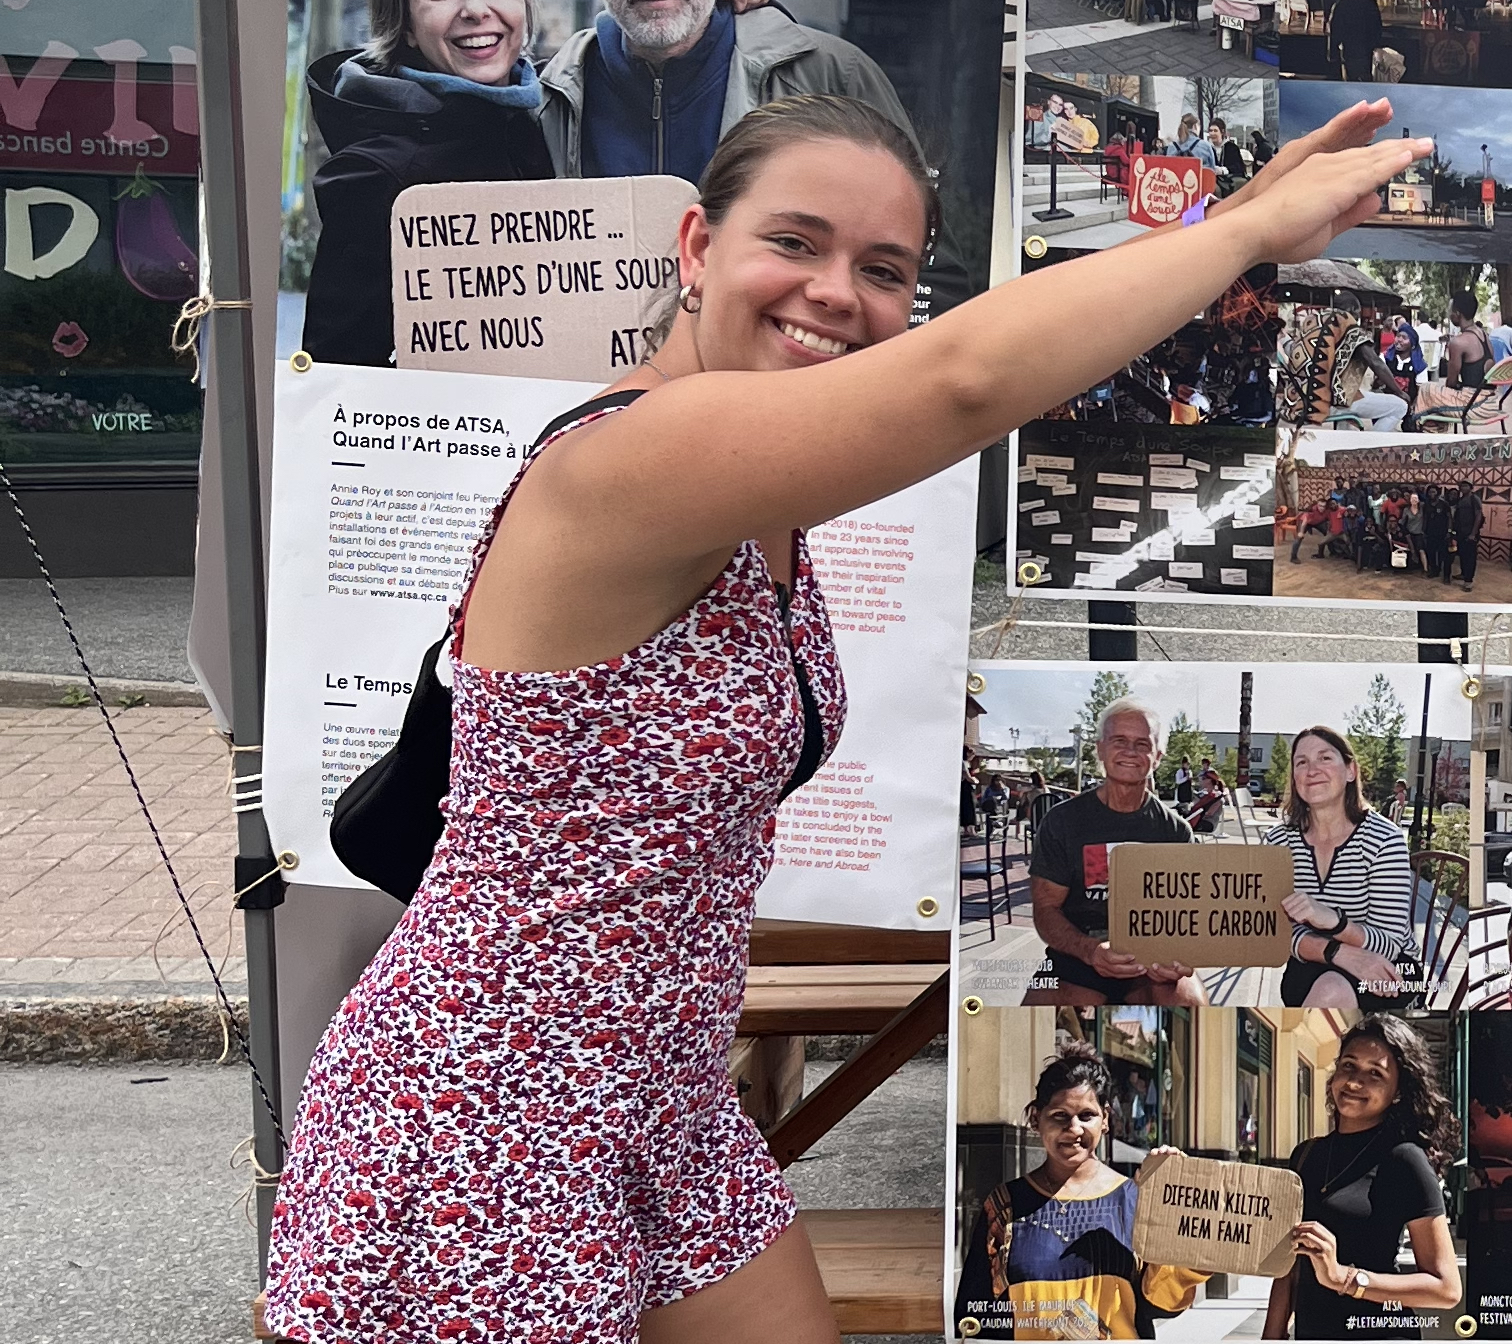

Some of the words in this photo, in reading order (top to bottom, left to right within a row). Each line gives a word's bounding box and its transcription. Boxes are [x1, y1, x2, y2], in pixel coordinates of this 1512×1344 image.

[1221, 16, 1242, 28] ATSA
[399, 213, 479, 248] VENEZ
[491, 208, 596, 244] PRENDRE
[404, 269, 433, 301] LE
[443, 265, 527, 299] TEMPS
[538, 260, 602, 294] D'UNE
[615, 256, 680, 290] SOUP
[411, 320, 469, 354] AVEC
[480, 316, 544, 351] NOUS
[91, 413, 153, 432] VOTRE
[333, 403, 346, 423] À
[353, 412, 420, 429] propos
[427, 415, 449, 430] de
[455, 416, 510, 437] ATSA,
[333, 431, 395, 449] Quand
[401, 436, 441, 453] l'Art
[448, 442, 500, 457] passe
[507, 443, 516, 458] à
[1076, 431, 1125, 449] Temps
[330, 483, 358, 494] Annie
[362, 486, 381, 497] Roy
[417, 491, 453, 501] conjoint
[456, 492, 470, 501] feu
[331, 496, 364, 507] Quand
[366, 499, 386, 508] l'Art
[388, 502, 417, 511] passe
[420, 503, 427, 511] à
[429, 504, 463, 514] l'Action
[465, 507, 476, 515] en
[861, 522, 914, 534] co-founded
[823, 532, 837, 540] the
[855, 535, 881, 544] years
[884, 536, 909, 546] since
[329, 560, 354, 570] place
[358, 562, 398, 574] publique
[401, 566, 412, 574] sa
[415, 566, 462, 577] dimension
[329, 573, 384, 584] discussions
[419, 579, 449, 589] débats
[328, 585, 349, 595] Plus
[352, 588, 367, 596] sur
[370, 590, 447, 602] www.atsa.qc.ca
[326, 673, 348, 690] Le
[354, 675, 413, 696] Temps
[324, 723, 342, 732] Une
[346, 727, 375, 735] œuvre
[379, 728, 399, 736] relat
[780, 844, 807, 854] Some
[810, 847, 832, 856] have
[836, 849, 855, 857] also
[858, 849, 881, 859] been
[1143, 871, 1201, 899] REUSE
[1210, 872, 1267, 904] STUFF,
[1129, 909, 1199, 937] REDUCE
[1208, 909, 1277, 937] CARBON
[1395, 963, 1415, 975] ATSA
[1163, 1183, 1219, 1211] DIFERAN
[1225, 1191, 1272, 1221] KILTIR,
[1177, 1215, 1210, 1239] MEM
[1217, 1220, 1252, 1244] FAMI
[967, 1300, 1017, 1313] PORT-LOUIS
[1382, 1300, 1402, 1311] ATSA
[981, 1317, 1013, 1329] CAUDAN
[1017, 1317, 1069, 1329] WATERFRONT
[1345, 1315, 1440, 1330] #LETEMPSDUNESOUPE
